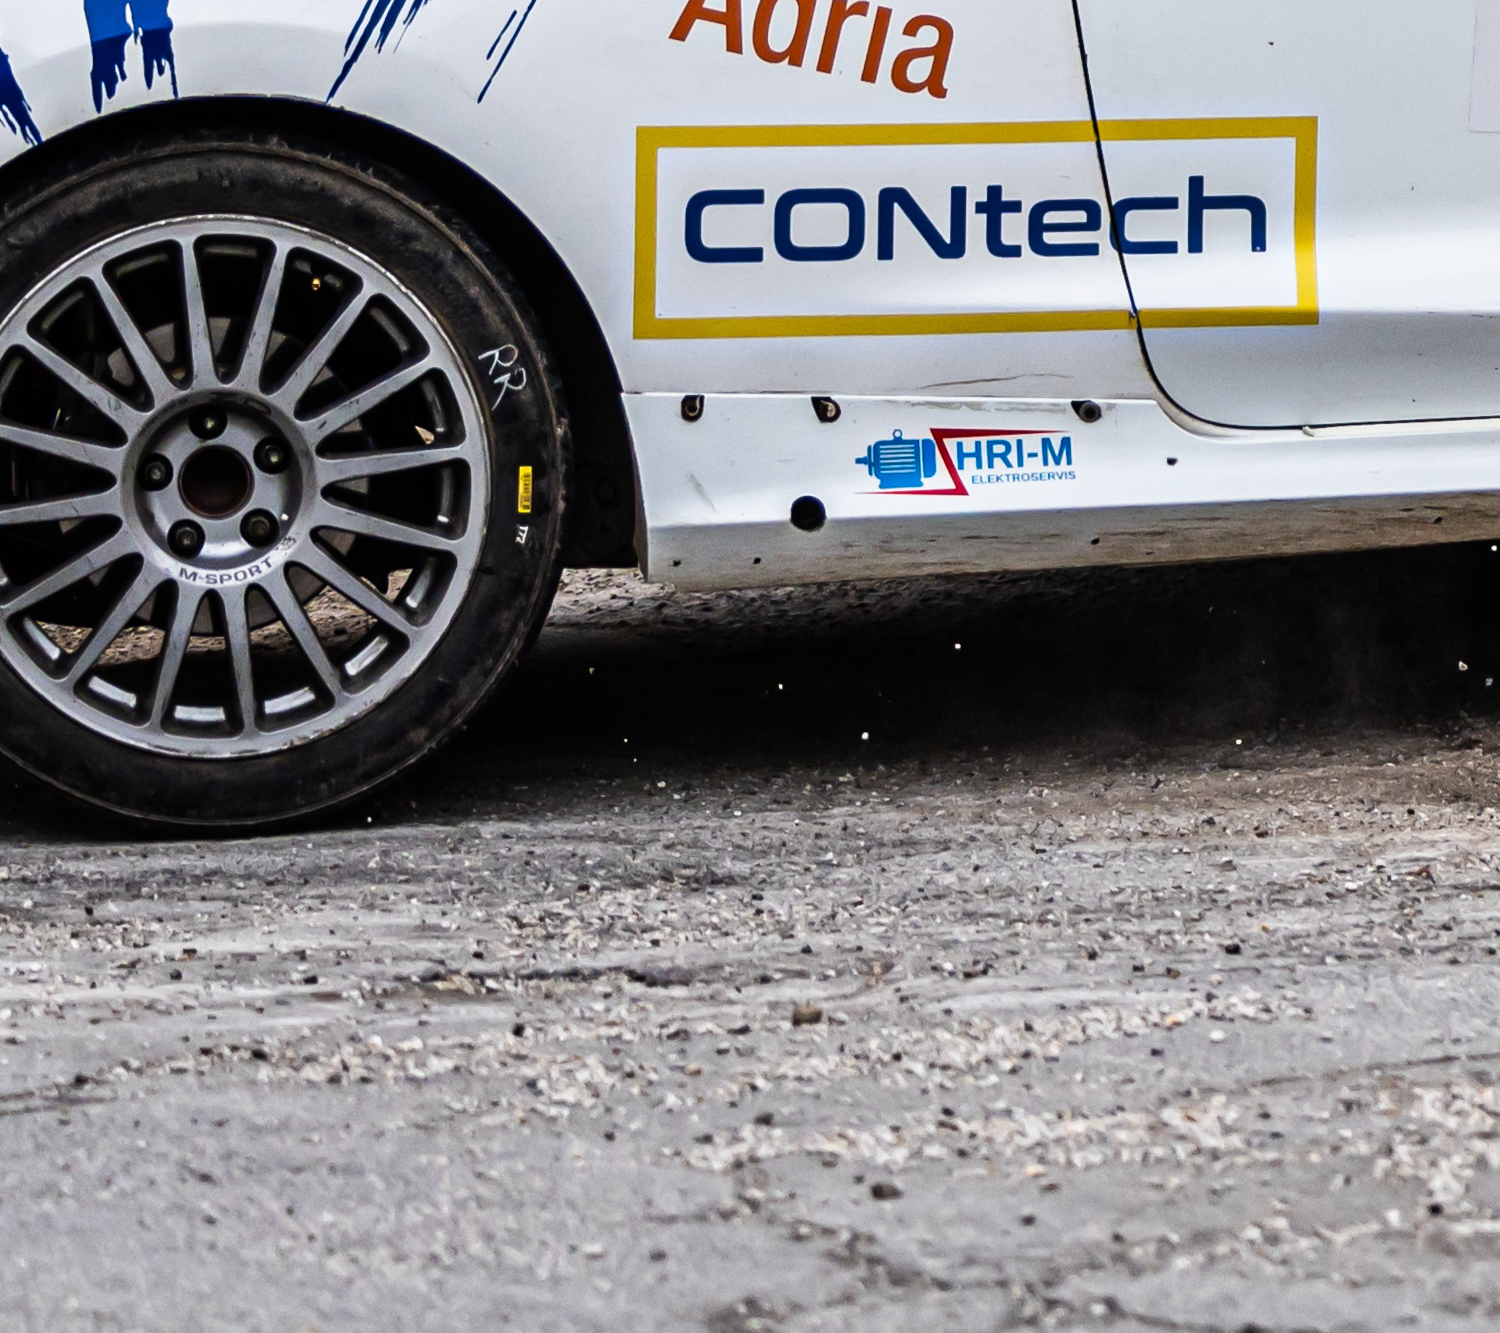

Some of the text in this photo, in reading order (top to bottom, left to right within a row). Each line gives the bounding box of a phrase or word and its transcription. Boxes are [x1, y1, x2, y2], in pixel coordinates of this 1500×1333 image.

[683, 175, 1268, 264] CONtech
[478, 344, 527, 411] RR
[956, 436, 1073, 470] HRI-M
[972, 471, 1076, 485] ELEKTROSERVIS
[180, 556, 274, 584] M-SPORT
